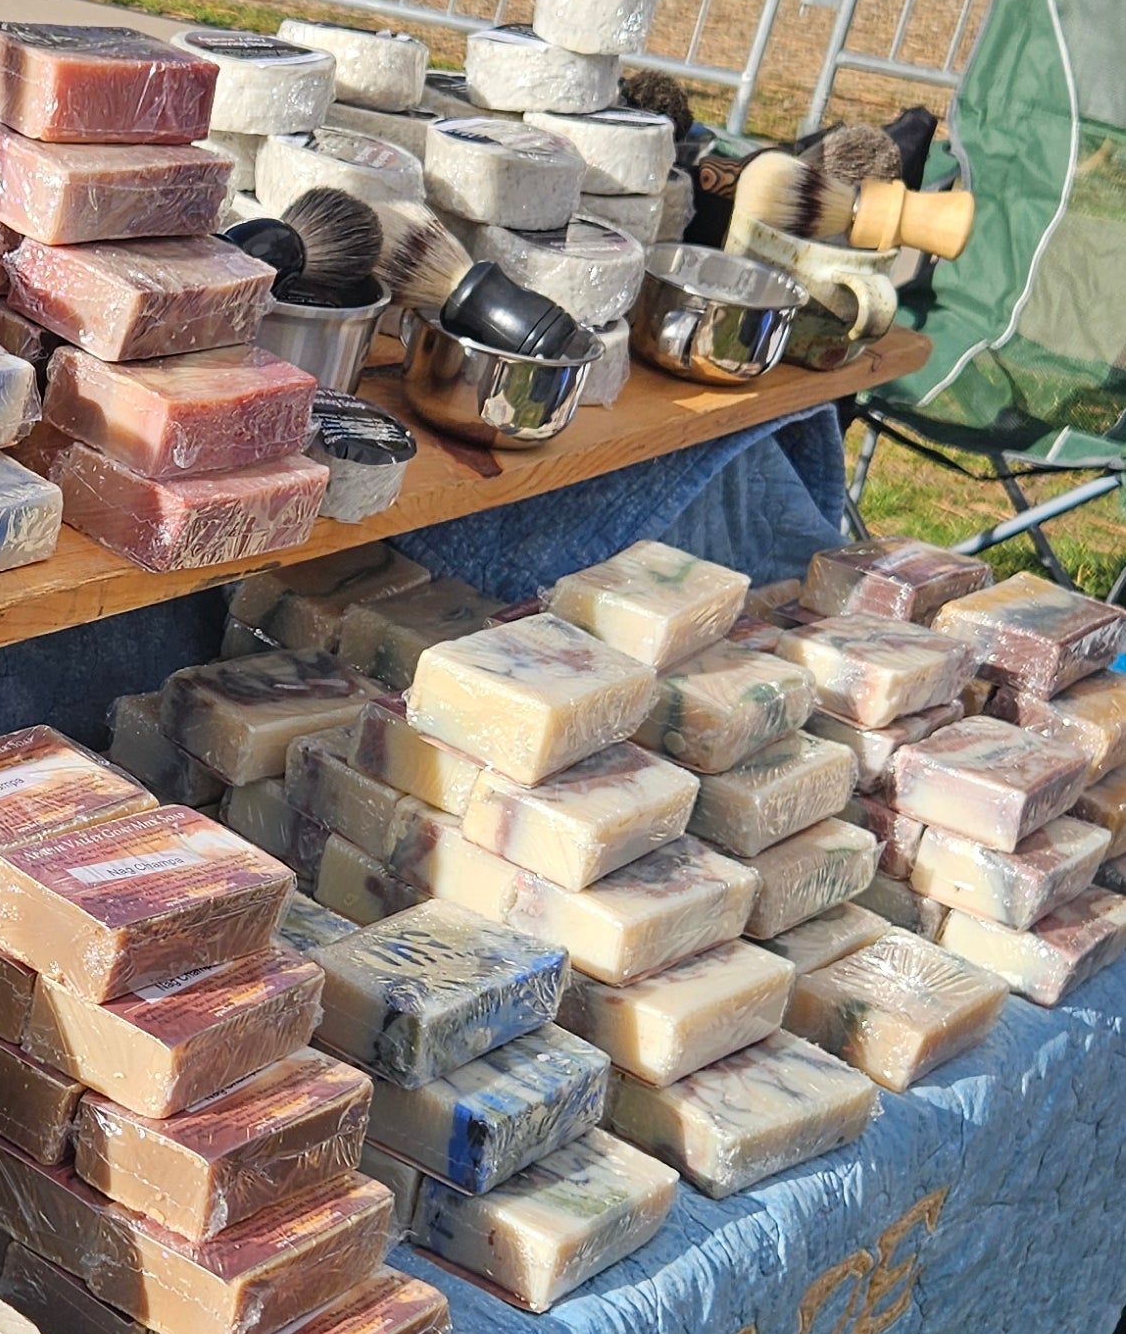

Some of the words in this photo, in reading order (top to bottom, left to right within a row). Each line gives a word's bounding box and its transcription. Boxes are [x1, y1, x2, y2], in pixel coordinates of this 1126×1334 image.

[23, 843, 68, 862] APACHE
[63, 834, 104, 850] VALLEY
[101, 825, 133, 838] GOAT
[130, 818, 159, 831] MILK
[156, 812, 186, 824] SOAP
[107, 866, 136, 877] Nag
[133, 856, 185, 871] Champa
